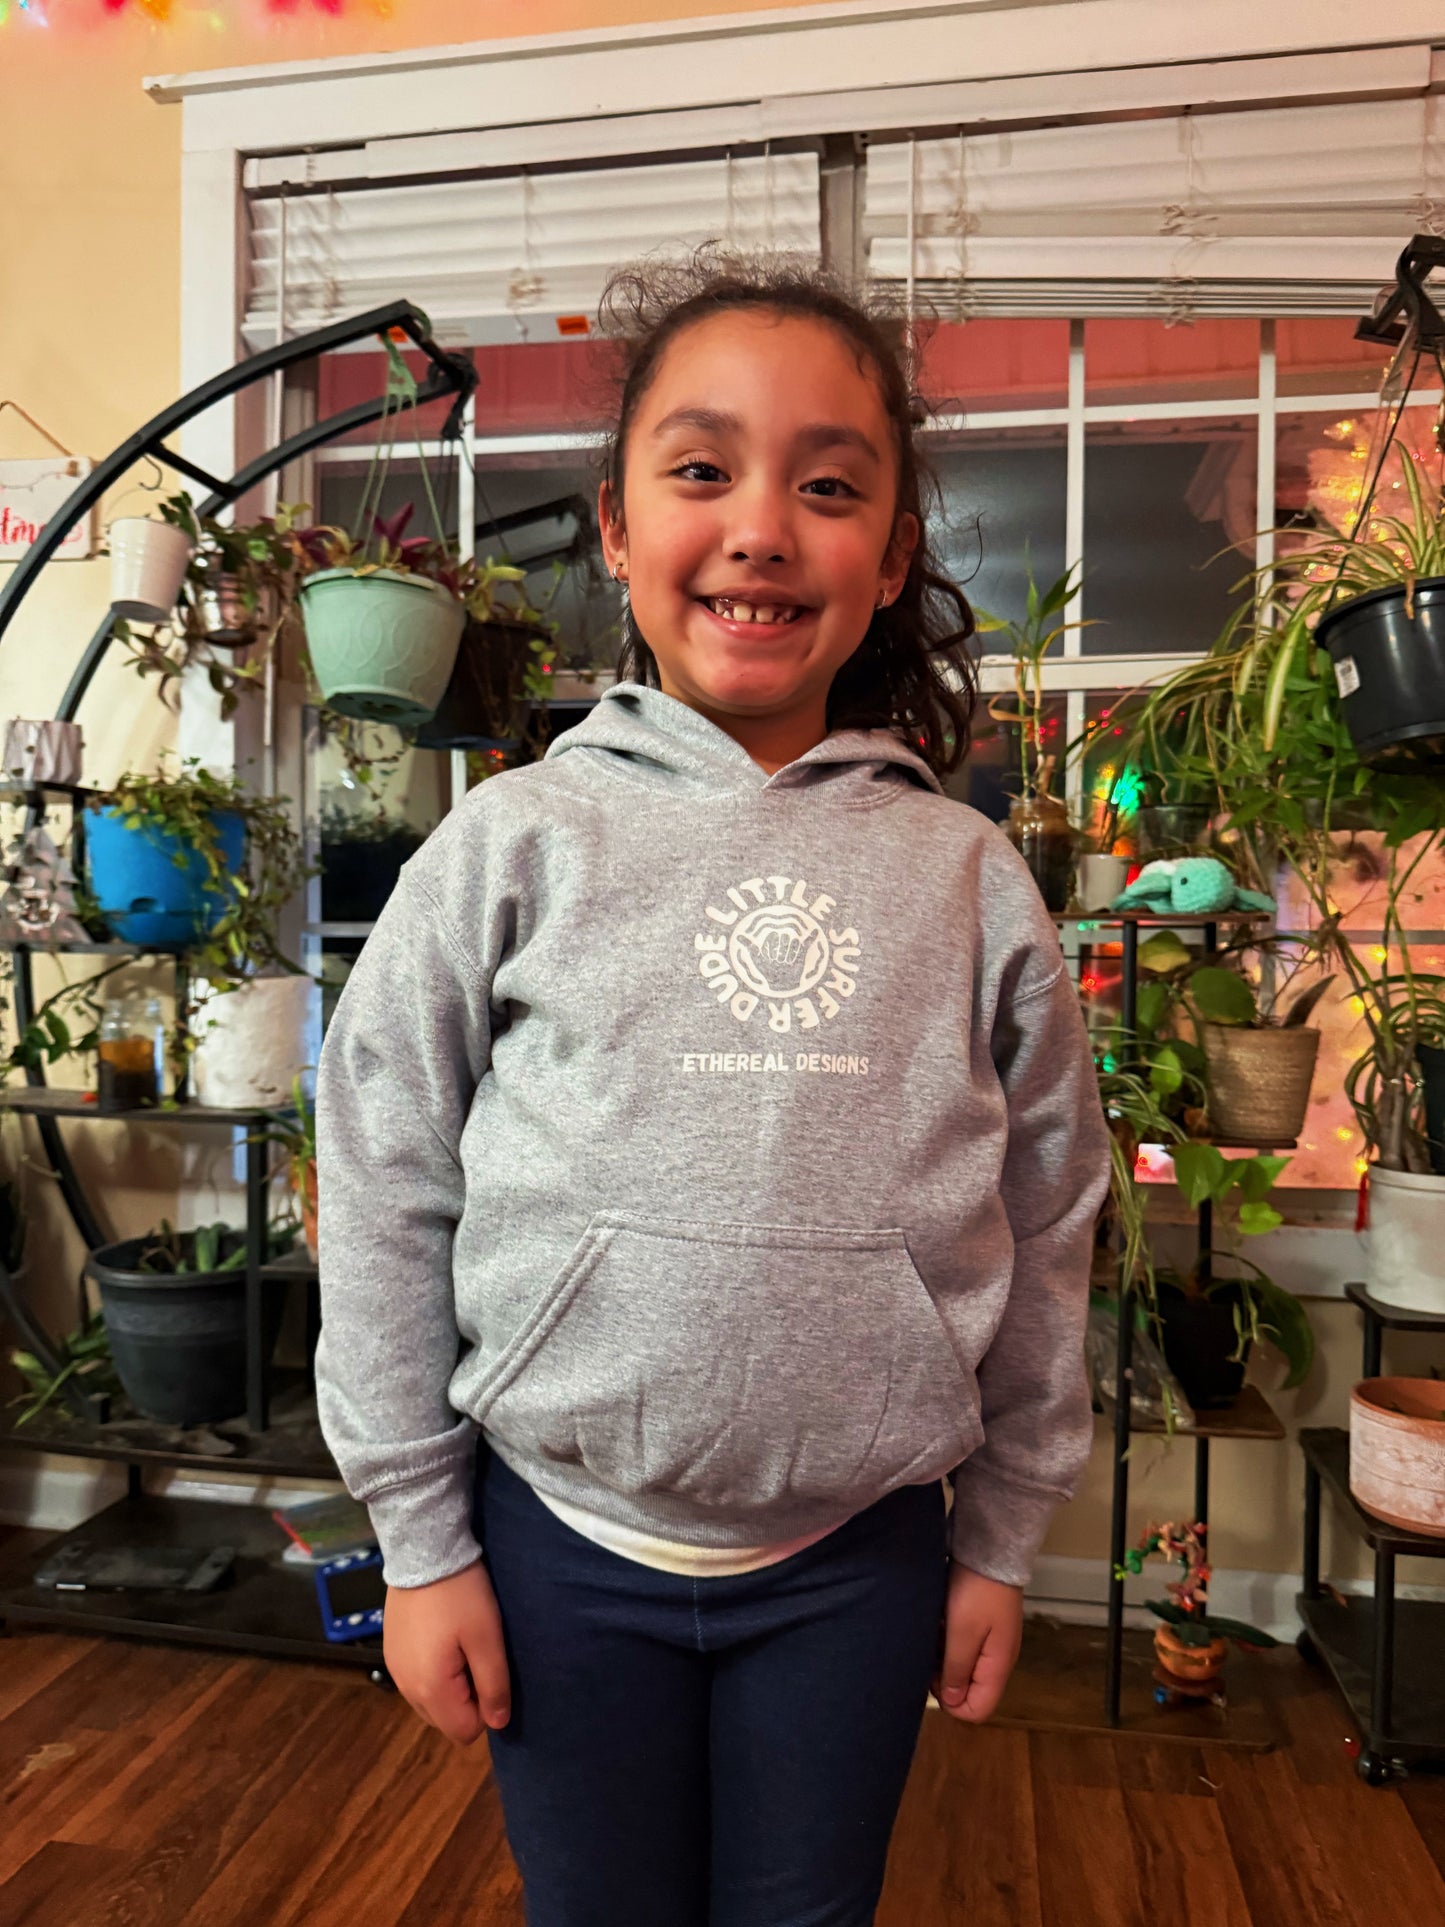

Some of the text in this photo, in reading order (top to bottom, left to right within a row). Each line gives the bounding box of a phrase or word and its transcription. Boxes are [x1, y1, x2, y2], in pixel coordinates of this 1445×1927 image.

[694, 876, 861, 1034] LITTLE SURFER DUDE
[682, 1053, 870, 1076] ETHEREAL DESIGNS
